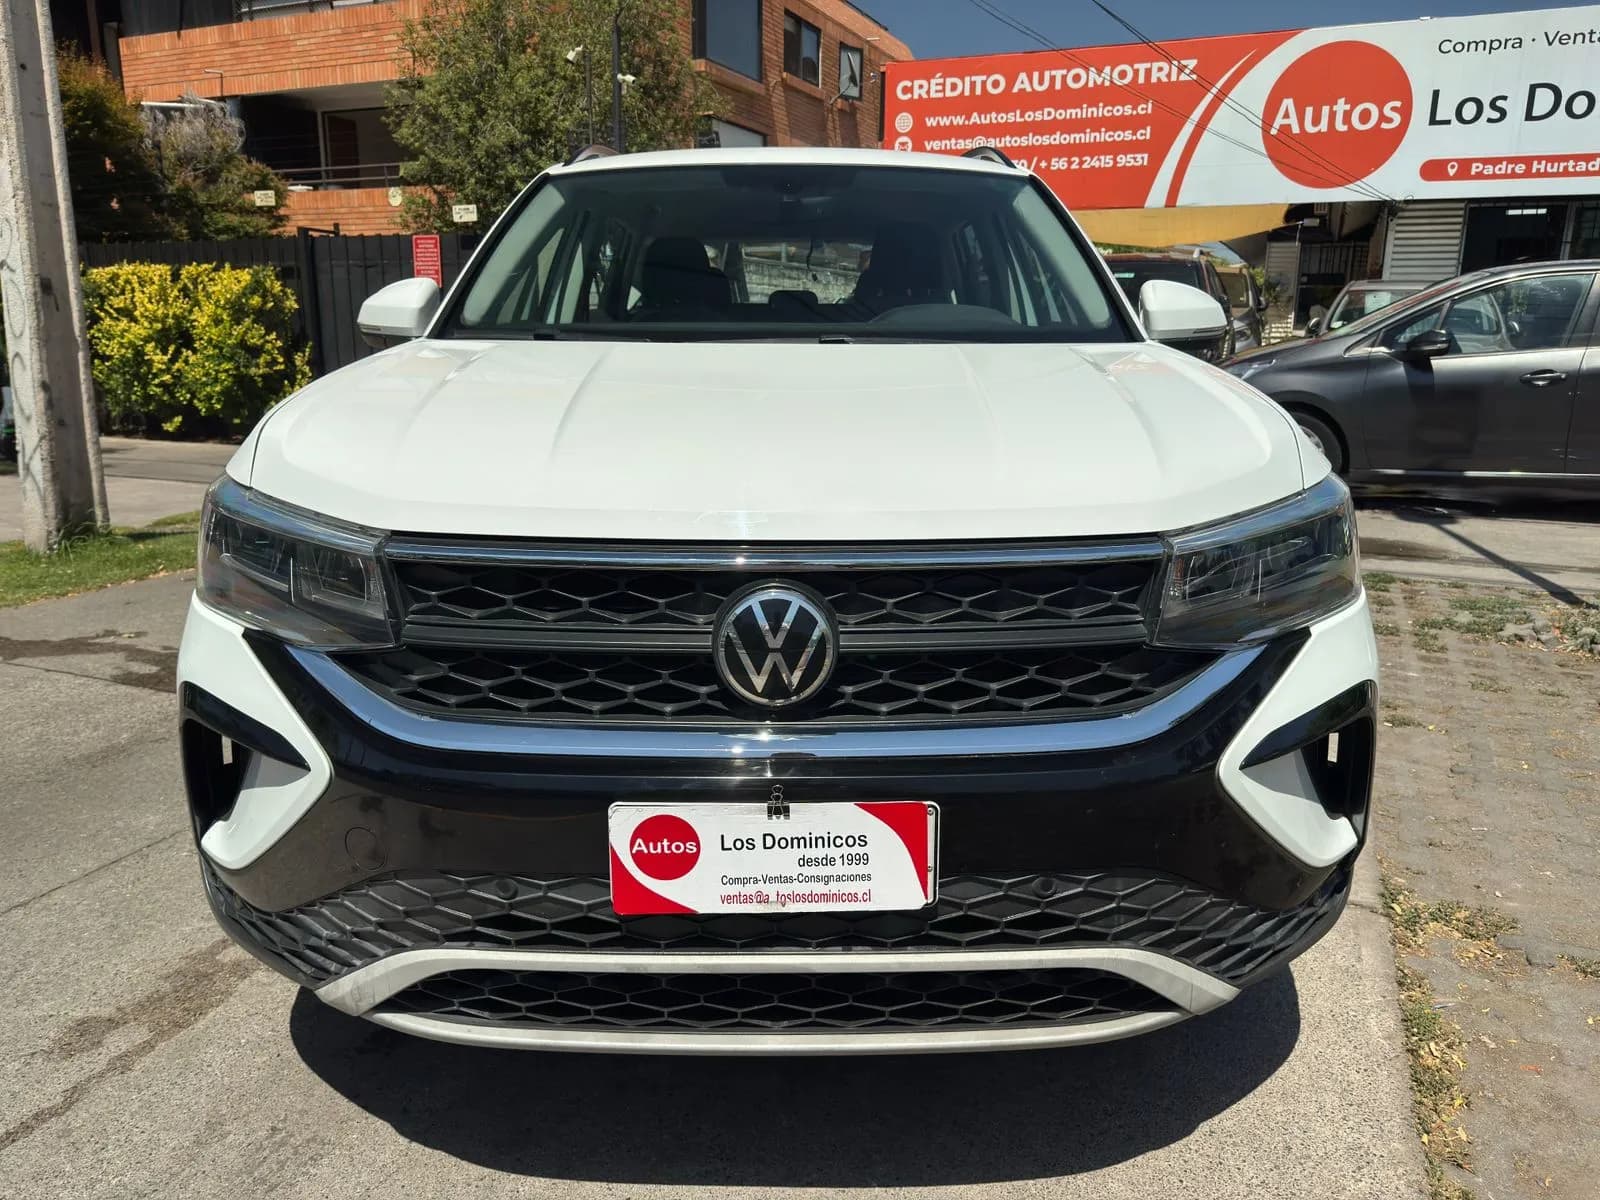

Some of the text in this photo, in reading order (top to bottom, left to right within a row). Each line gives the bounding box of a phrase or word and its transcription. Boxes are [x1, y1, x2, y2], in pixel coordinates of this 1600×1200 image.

[1438, 28, 1600, 55] Compra Vent
[896, 59, 1198, 101] CRÉDITO AUTOMOTRIZ
[925, 100, 1153, 128] www.AutosLosDominicos.cl
[1270, 97, 1402, 135] Autos
[1428, 88, 1508, 127] Los
[924, 126, 1151, 151] ventas@autoslosdominicos.cl
[1050, 157, 1068, 170] 56
[1070, 157, 1080, 169] 2
[1081, 155, 1114, 169] 2415
[1116, 153, 1149, 167] 9531
[1470, 160, 1526, 175] Padre
[631, 837, 698, 854] Autos
[720, 831, 869, 851] Los Dominicos
[797, 852, 870, 867] desde 1999
[720, 872, 873, 887] Compra-Ventas-Consignaciones
[720, 889, 872, 905] ventas@atoslosdominicos.cl
